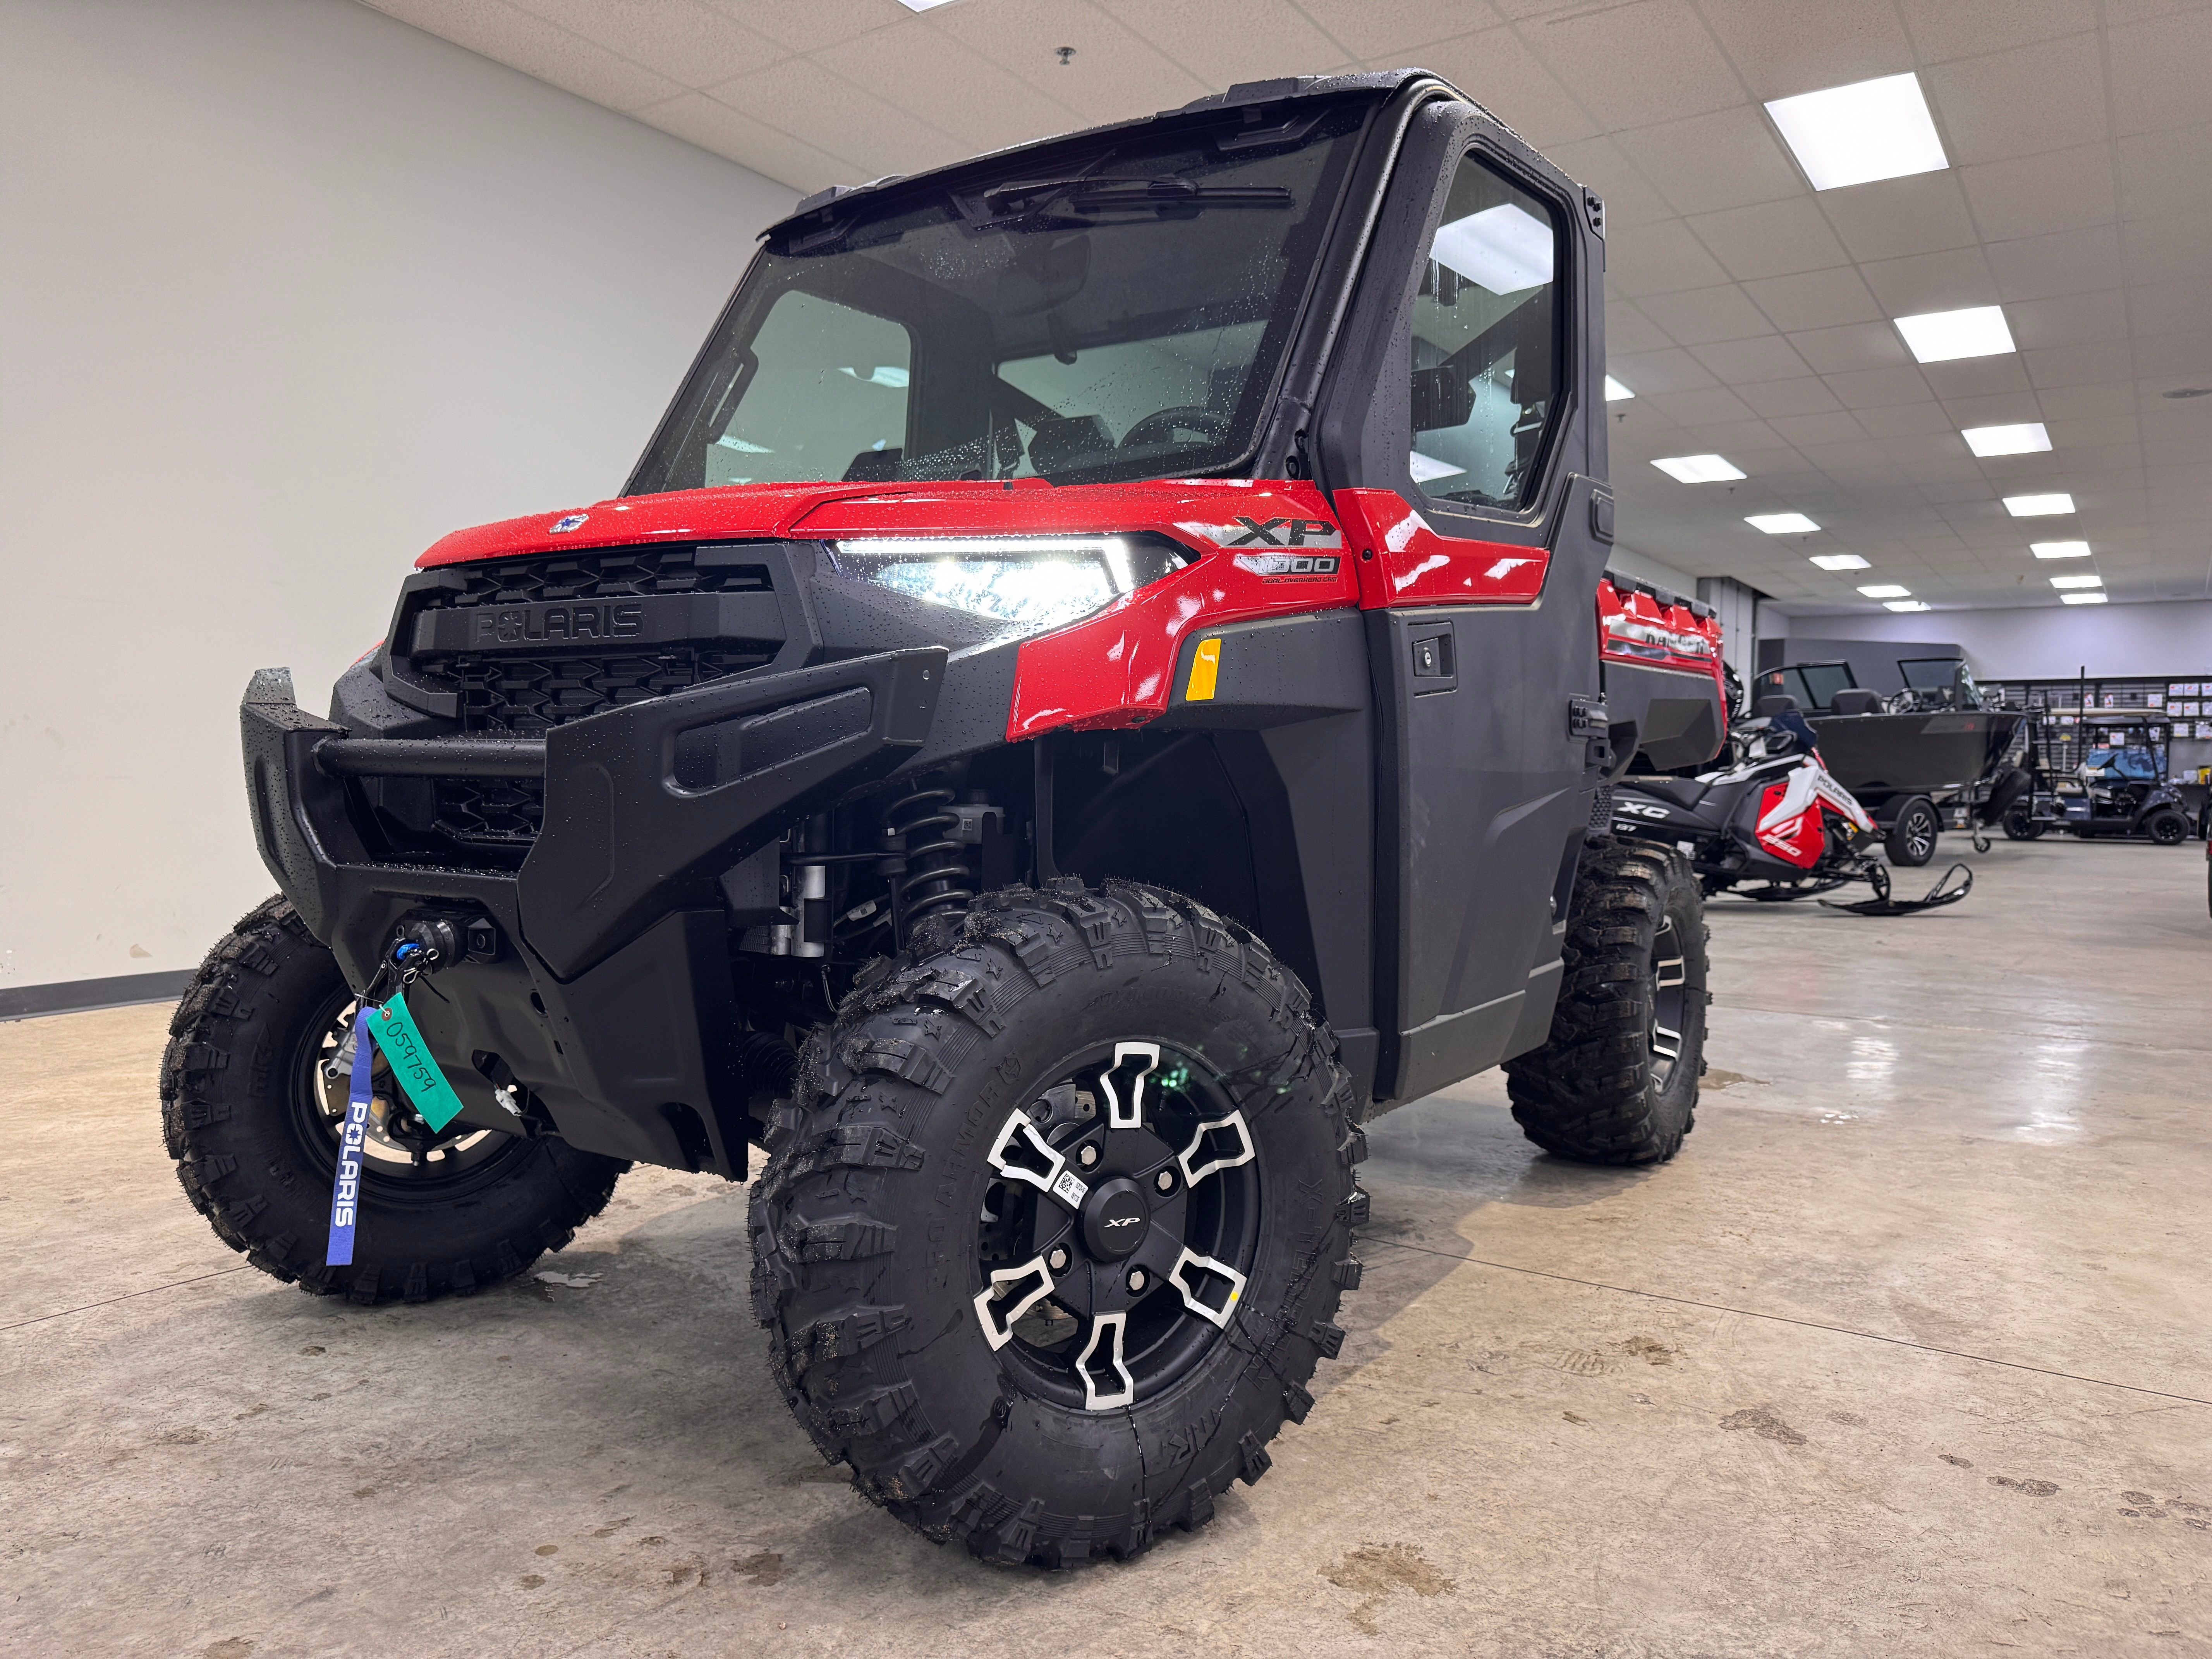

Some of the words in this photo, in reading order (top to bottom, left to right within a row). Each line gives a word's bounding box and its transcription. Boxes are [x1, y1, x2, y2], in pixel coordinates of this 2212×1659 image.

[1227, 517, 1337, 546] XP
[1257, 557, 1335, 574] 1000
[476, 603, 644, 643] POLARIS
[1817, 775, 1853, 806] POLARIS
[1617, 801, 1671, 819] XC
[1762, 834, 1803, 857] 850
[386, 1021, 437, 1093] 059759
[935, 1080, 1000, 1207] ARMOR
[335, 1101, 368, 1228] POLARIS
[1104, 1217, 1140, 1229] XP
